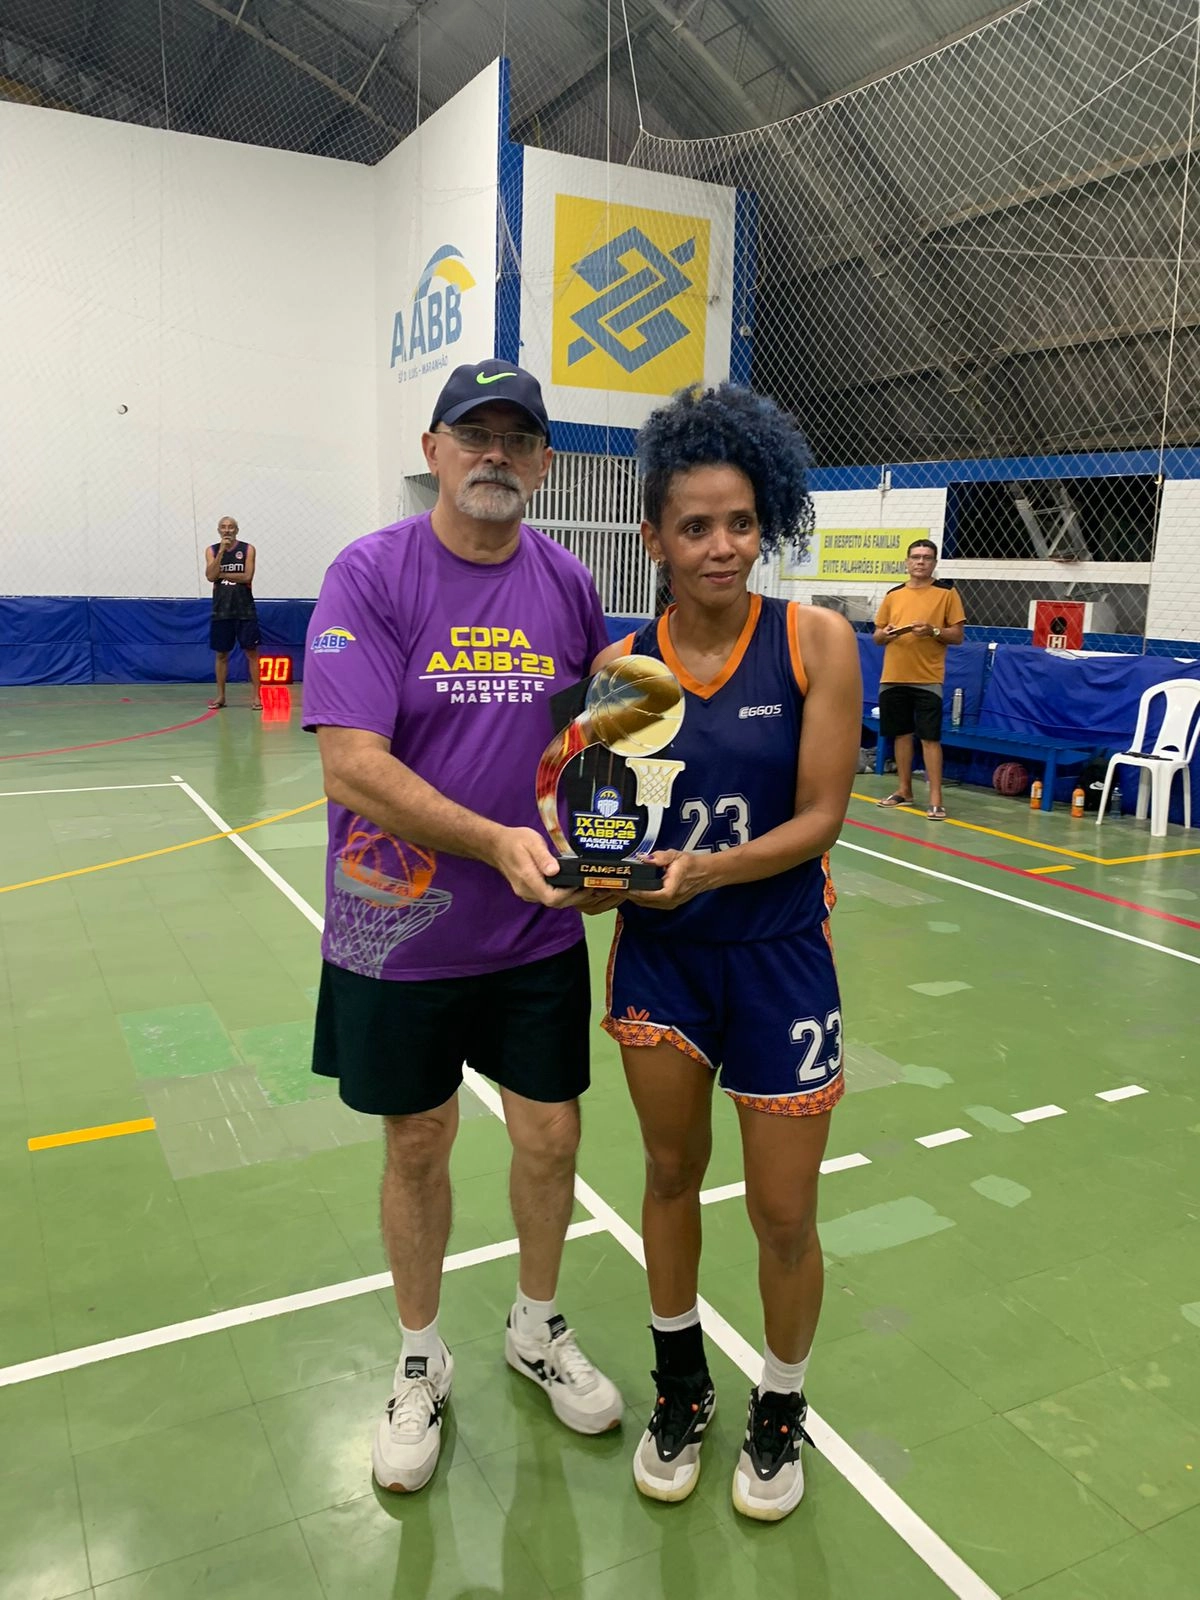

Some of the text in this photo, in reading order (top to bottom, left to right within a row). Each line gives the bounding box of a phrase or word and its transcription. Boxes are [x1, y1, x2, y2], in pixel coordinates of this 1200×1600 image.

[390, 284, 463, 369] AABB
[833, 534, 862, 549] RESPEITO
[822, 559, 840, 574] EVITE
[874, 560, 880, 574] E
[311, 635, 348, 649] AABB
[450, 626, 532, 650] COPA
[436, 679, 545, 693] BASQUETE
[450, 692, 533, 704] MASTER
[576, 817, 636, 831] IX COPA
[680, 792, 752, 854] 23
[579, 836, 631, 846] BASQUETE
[585, 843, 624, 851] MASTER
[787, 1007, 844, 1086] 23
